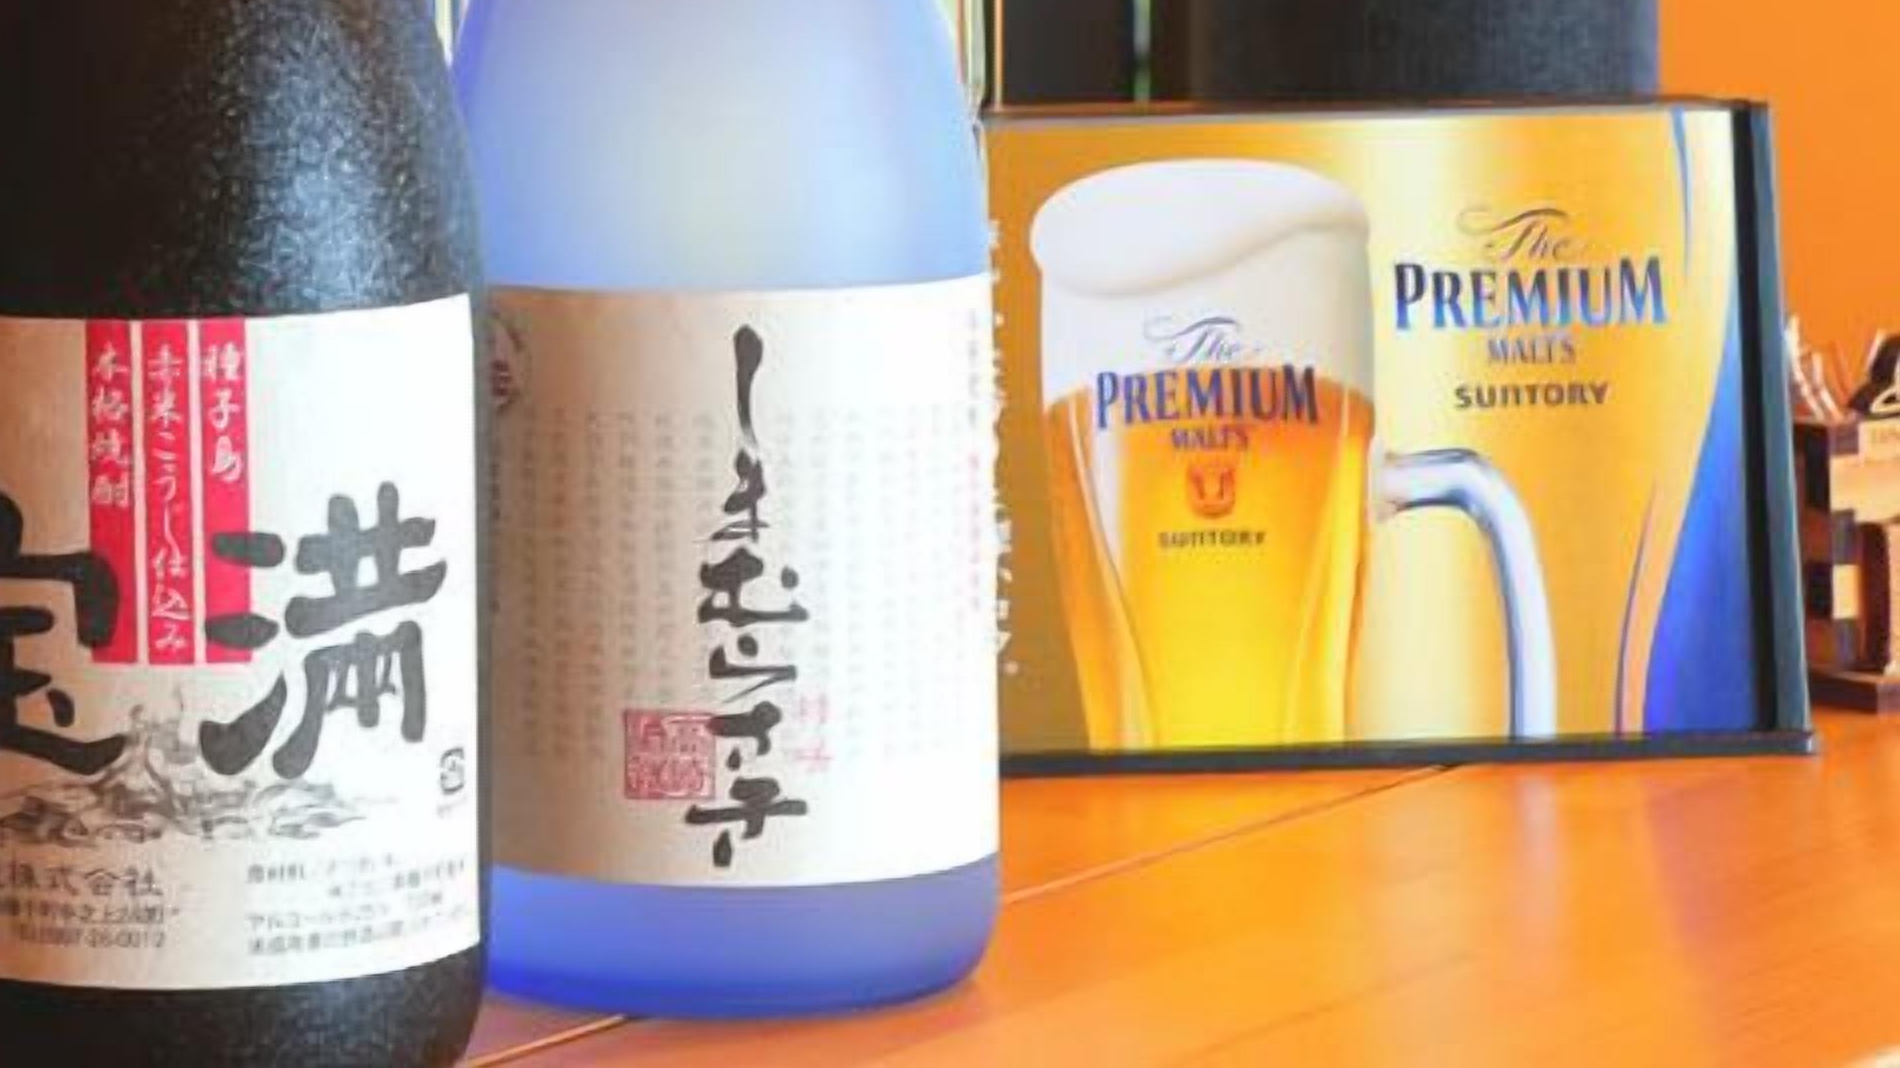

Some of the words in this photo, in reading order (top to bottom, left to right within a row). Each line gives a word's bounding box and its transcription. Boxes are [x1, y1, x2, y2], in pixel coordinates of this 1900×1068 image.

[1395, 256, 1667, 329] PREMIUM
[92, 339, 130, 509] 本格焼酎
[203, 341, 242, 483] 種子島
[1097, 364, 1319, 430] PREMIUM
[1455, 382, 1608, 409] SUNTORY
